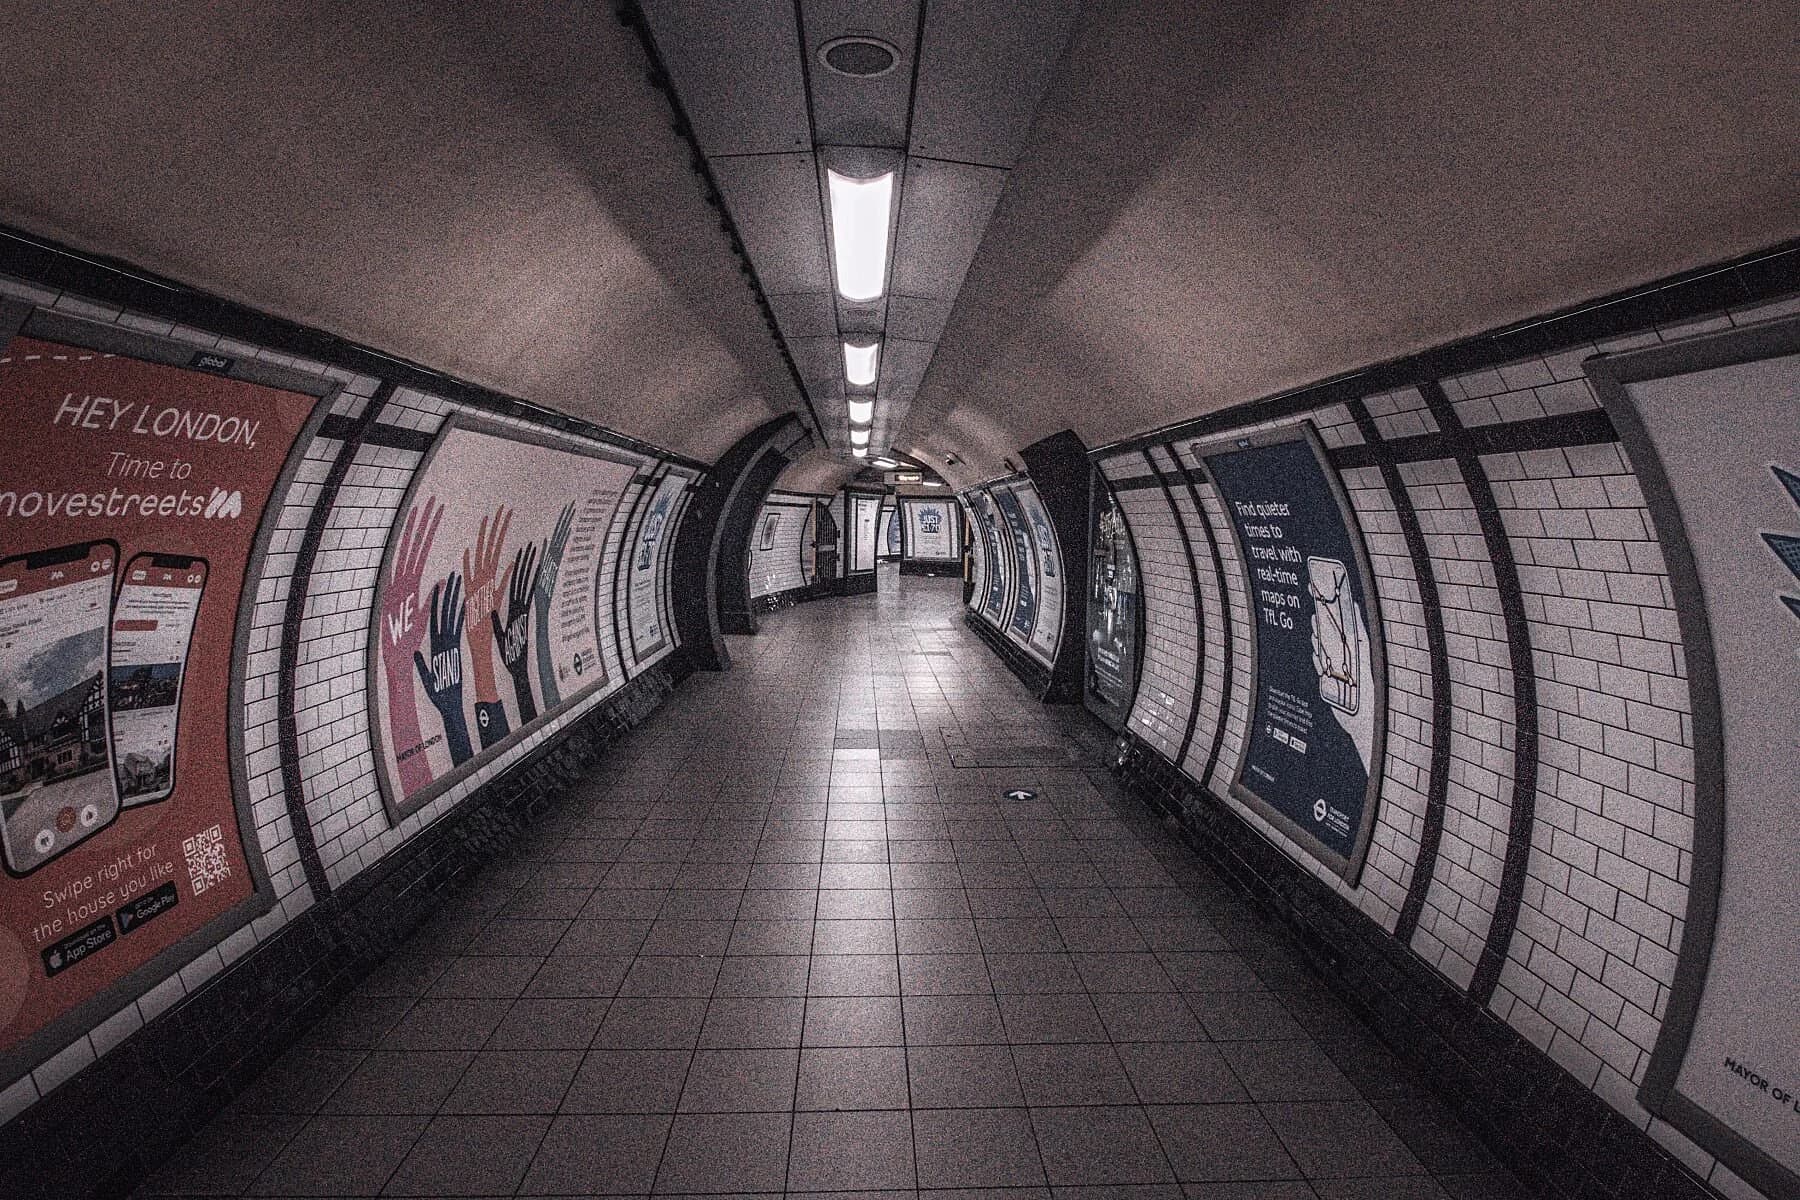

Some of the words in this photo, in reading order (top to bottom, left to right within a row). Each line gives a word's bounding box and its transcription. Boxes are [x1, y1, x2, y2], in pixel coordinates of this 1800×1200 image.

[53, 392, 134, 430] HEY
[133, 404, 260, 450] LONDON,
[106, 451, 164, 479] Time
[169, 458, 192, 480] to
[1235, 501, 1257, 517] Find
[1256, 500, 1290, 520] quieter
[1244, 522, 1271, 538] times
[1269, 523, 1283, 538] to
[1251, 544, 1279, 561] travel
[1278, 545, 1302, 563] with
[1257, 564, 1299, 586] real-time
[1261, 589, 1286, 609] maps
[1287, 594, 1301, 609] on
[388, 592, 415, 646] WE
[1263, 607, 1279, 626] TfL
[1279, 611, 1293, 630] Go
[432, 647, 460, 693] STAND
[43, 875, 94, 909] Swipe
[97, 854, 133, 883] right
[136, 844, 157, 863] for
[32, 919, 64, 943] the
[67, 891, 117, 925] house
[119, 874, 147, 901] you
[149, 861, 174, 882] like
[136, 901, 161, 919] Google
[66, 945, 87, 960] App
[86, 930, 112, 950] Store
[1724, 1056, 1769, 1093] MAYOR
[1771, 1087, 1792, 1105] OF
